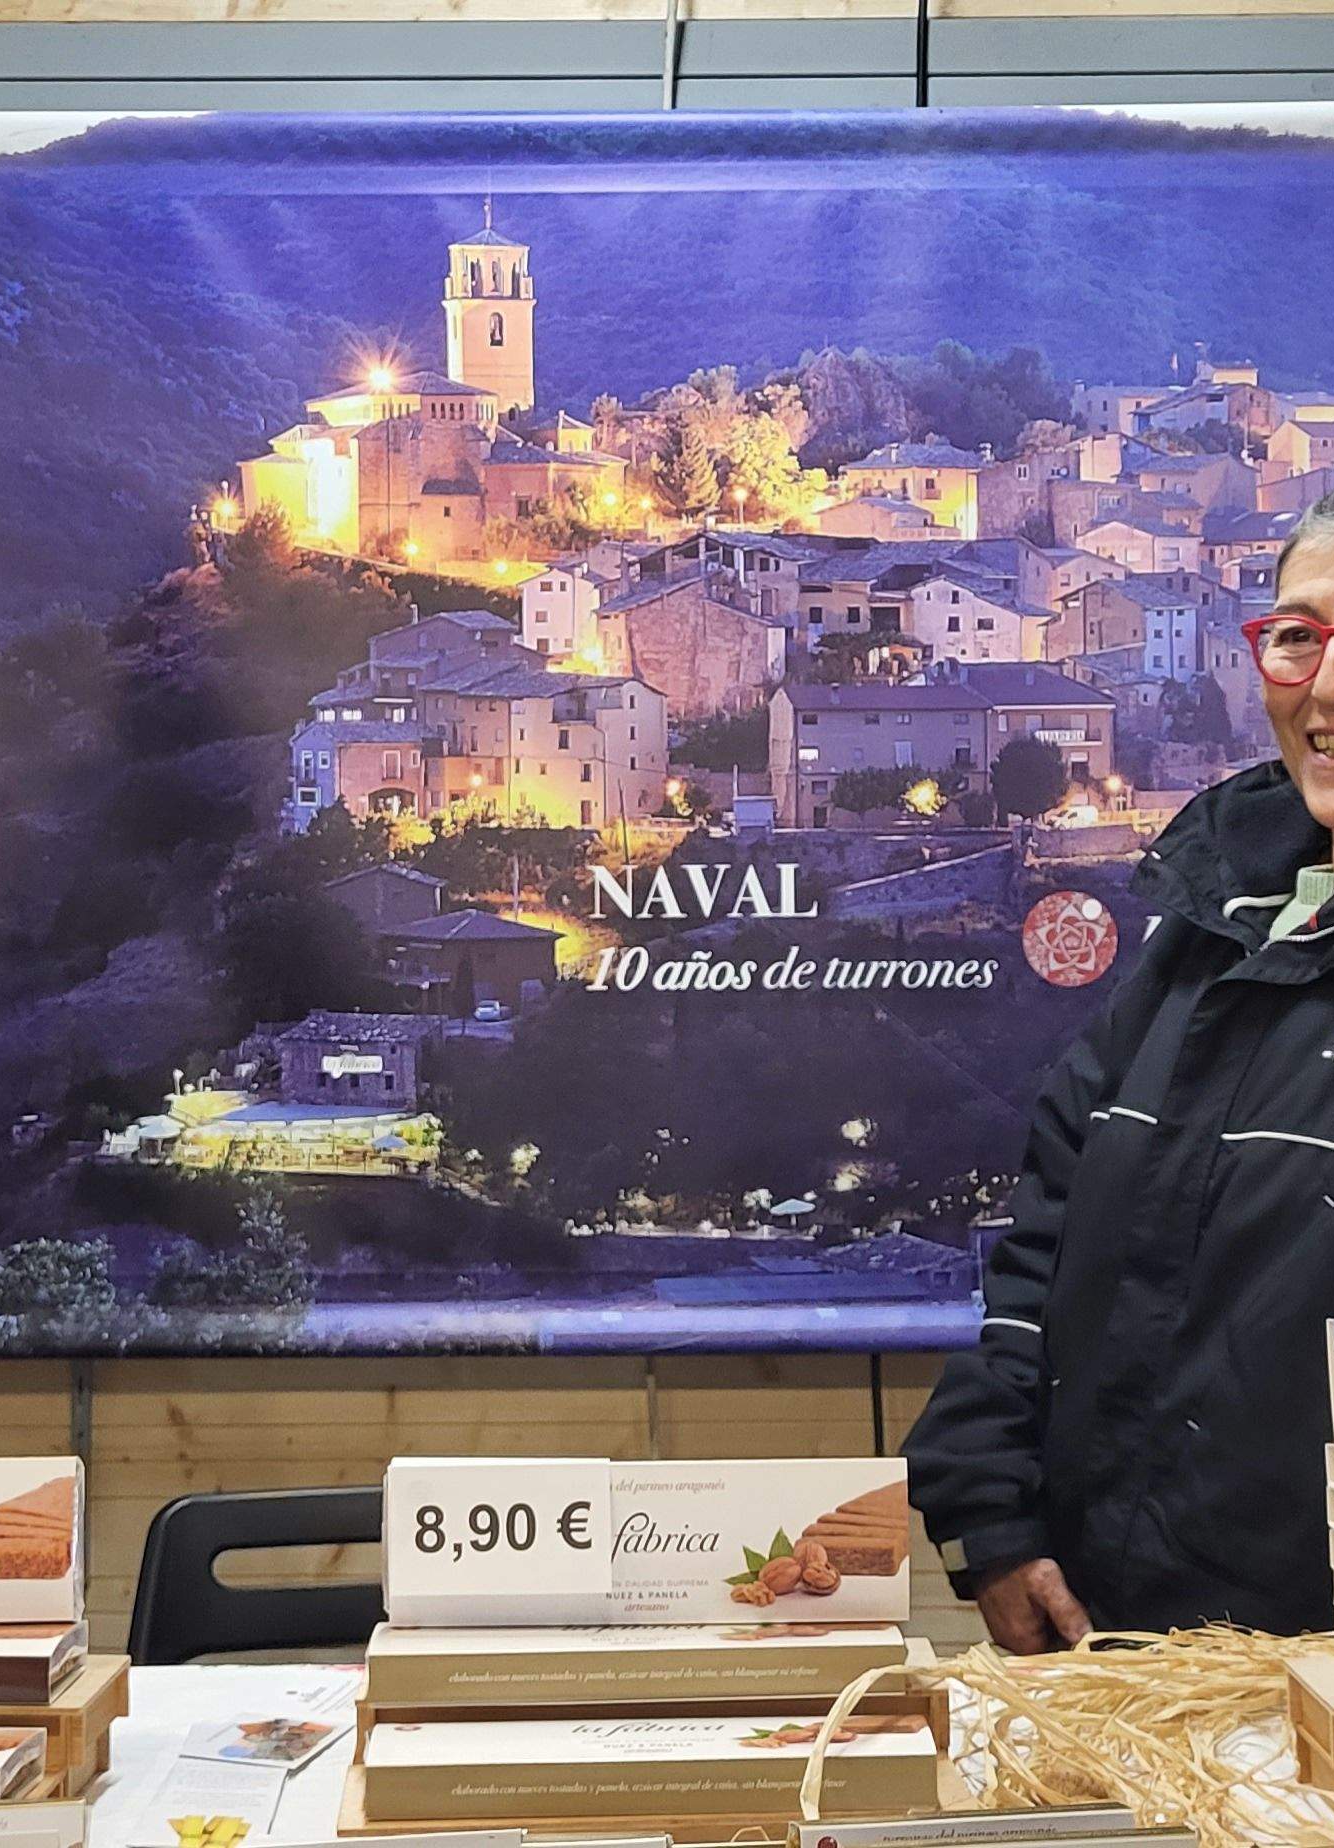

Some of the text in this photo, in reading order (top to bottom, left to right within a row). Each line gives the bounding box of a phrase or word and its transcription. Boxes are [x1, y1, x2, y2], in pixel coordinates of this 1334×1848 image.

[588, 863, 819, 919] NAVAL
[586, 946, 999, 992] 10 años de turrones
[414, 1500, 593, 1563] 8,90 €
[648, 1590, 688, 1599] PANELA
